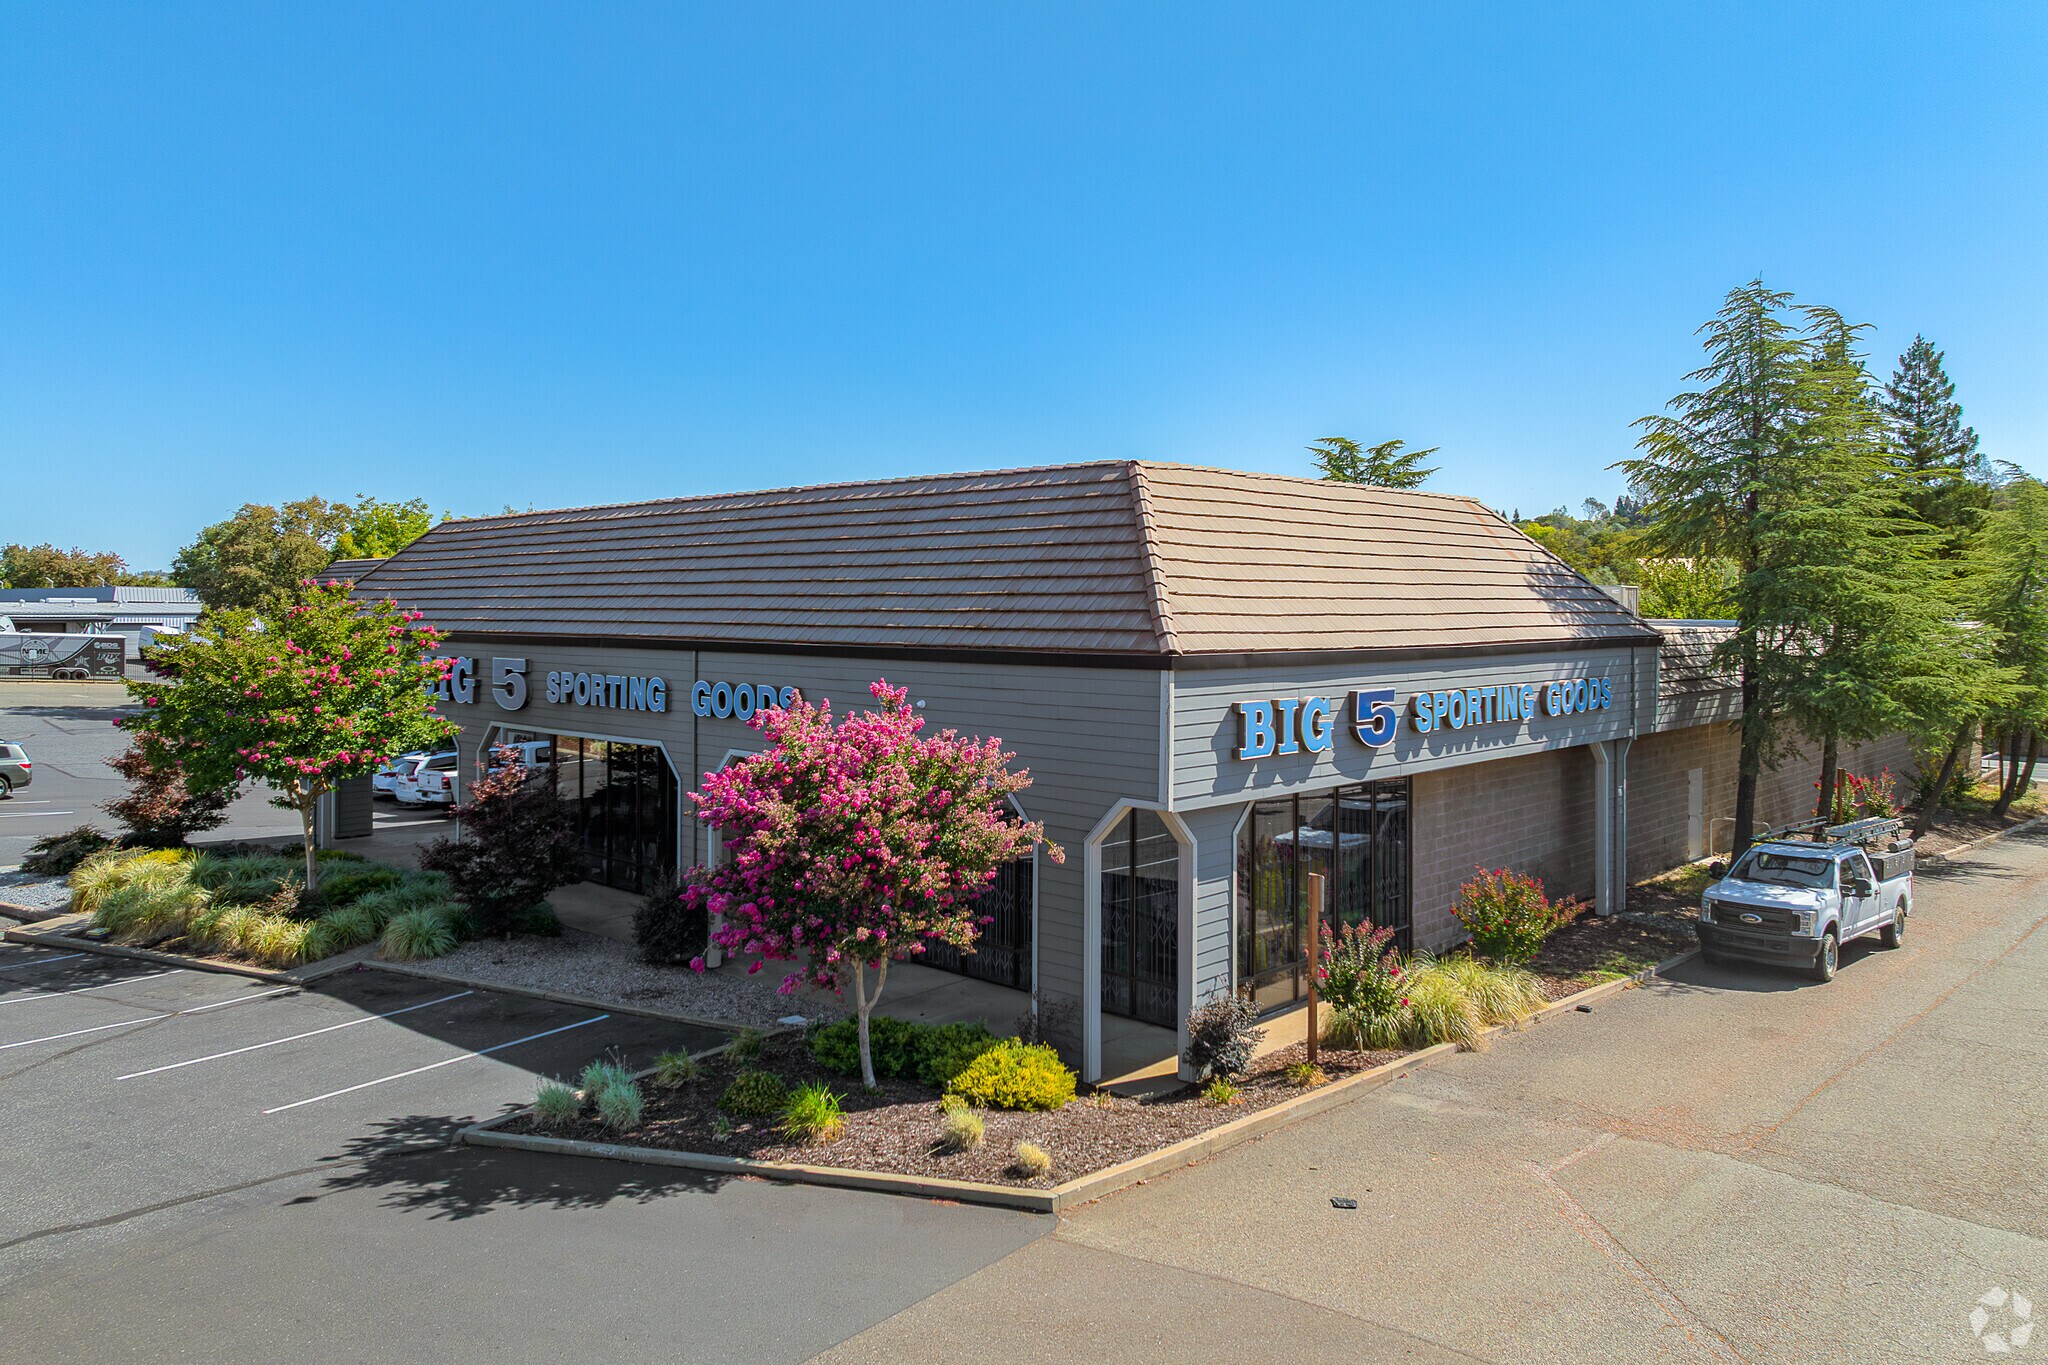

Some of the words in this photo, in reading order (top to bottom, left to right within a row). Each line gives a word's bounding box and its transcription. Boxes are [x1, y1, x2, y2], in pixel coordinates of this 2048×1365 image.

[491, 656, 529, 711] 5
[546, 671, 667, 712] SPORTING
[1237, 695, 1335, 761] BIG
[1352, 686, 1397, 749] 5
[1412, 684, 1535, 734] SPORTING
[1544, 676, 1612, 717] GOODS
